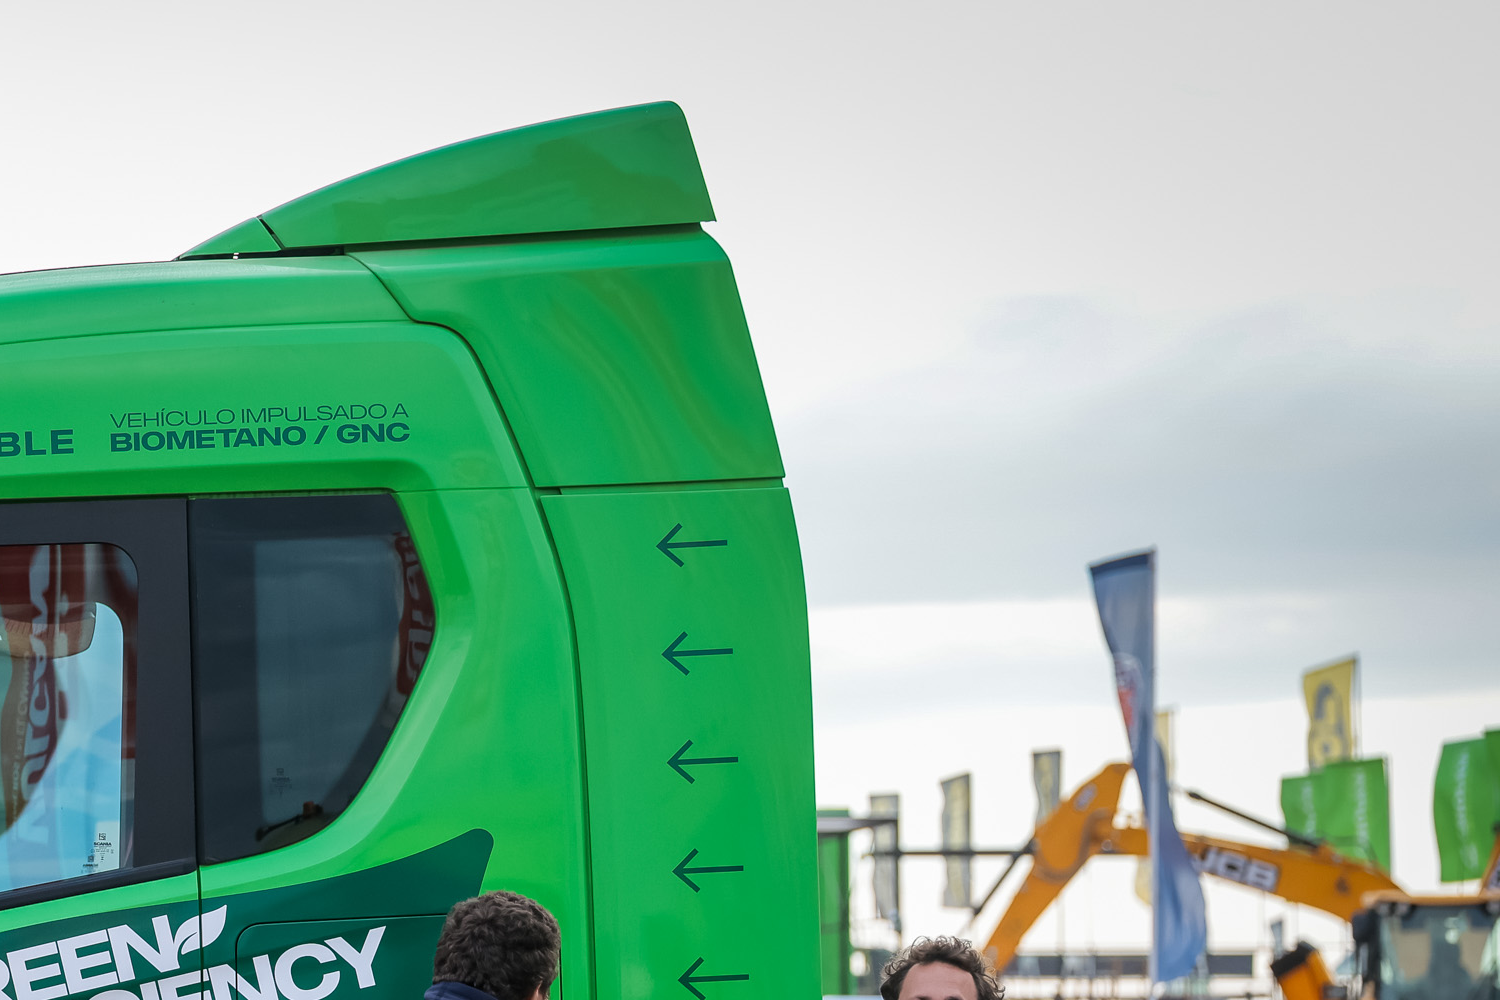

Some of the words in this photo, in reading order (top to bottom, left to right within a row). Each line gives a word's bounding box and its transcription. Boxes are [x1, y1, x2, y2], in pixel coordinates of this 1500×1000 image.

[110, 406, 235, 428] VEHÍCULO
[241, 403, 387, 423] IMPULSADO
[392, 403, 409, 418] A
[110, 425, 306, 452] BIOMETANO
[336, 422, 410, 444] GNC
